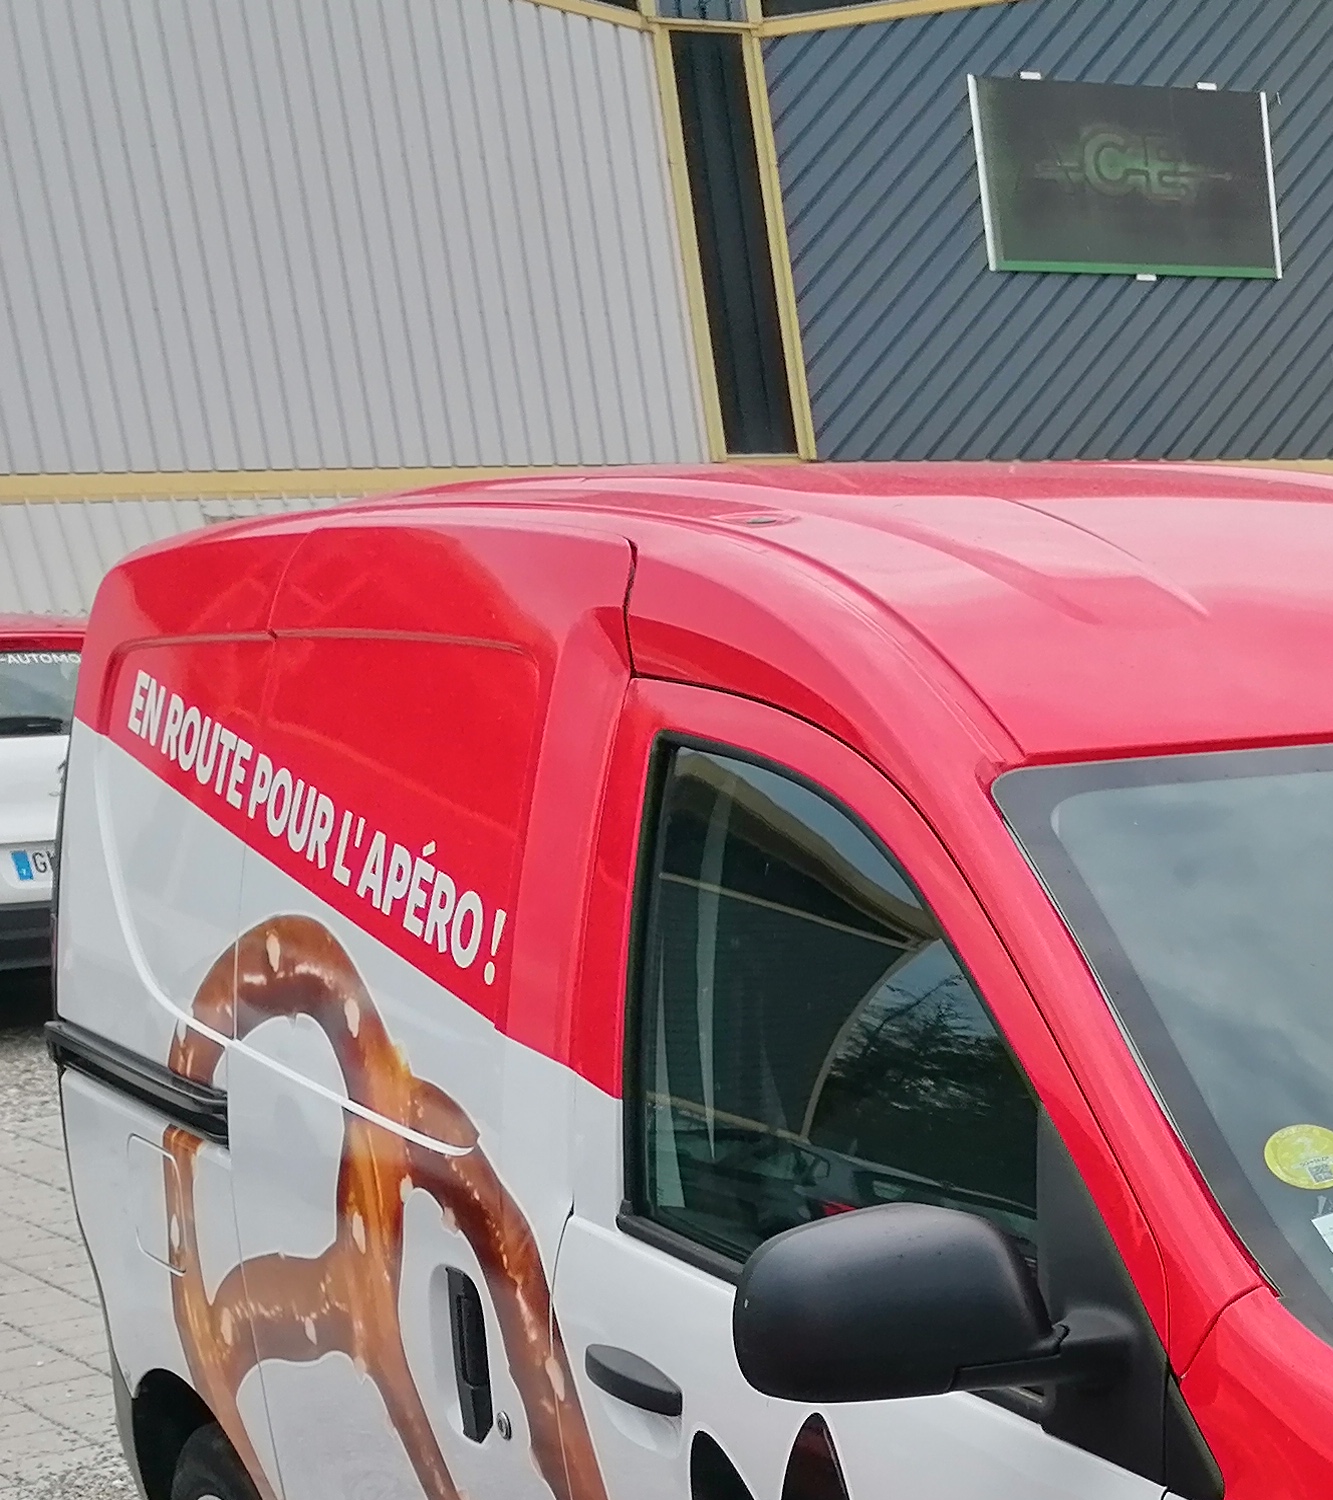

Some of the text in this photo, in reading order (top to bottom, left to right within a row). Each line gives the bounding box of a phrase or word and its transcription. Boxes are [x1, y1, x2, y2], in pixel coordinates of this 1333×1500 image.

[127, 669, 167, 745] EN
[161, 693, 253, 810] ROUTE
[247, 752, 335, 869] POUR
